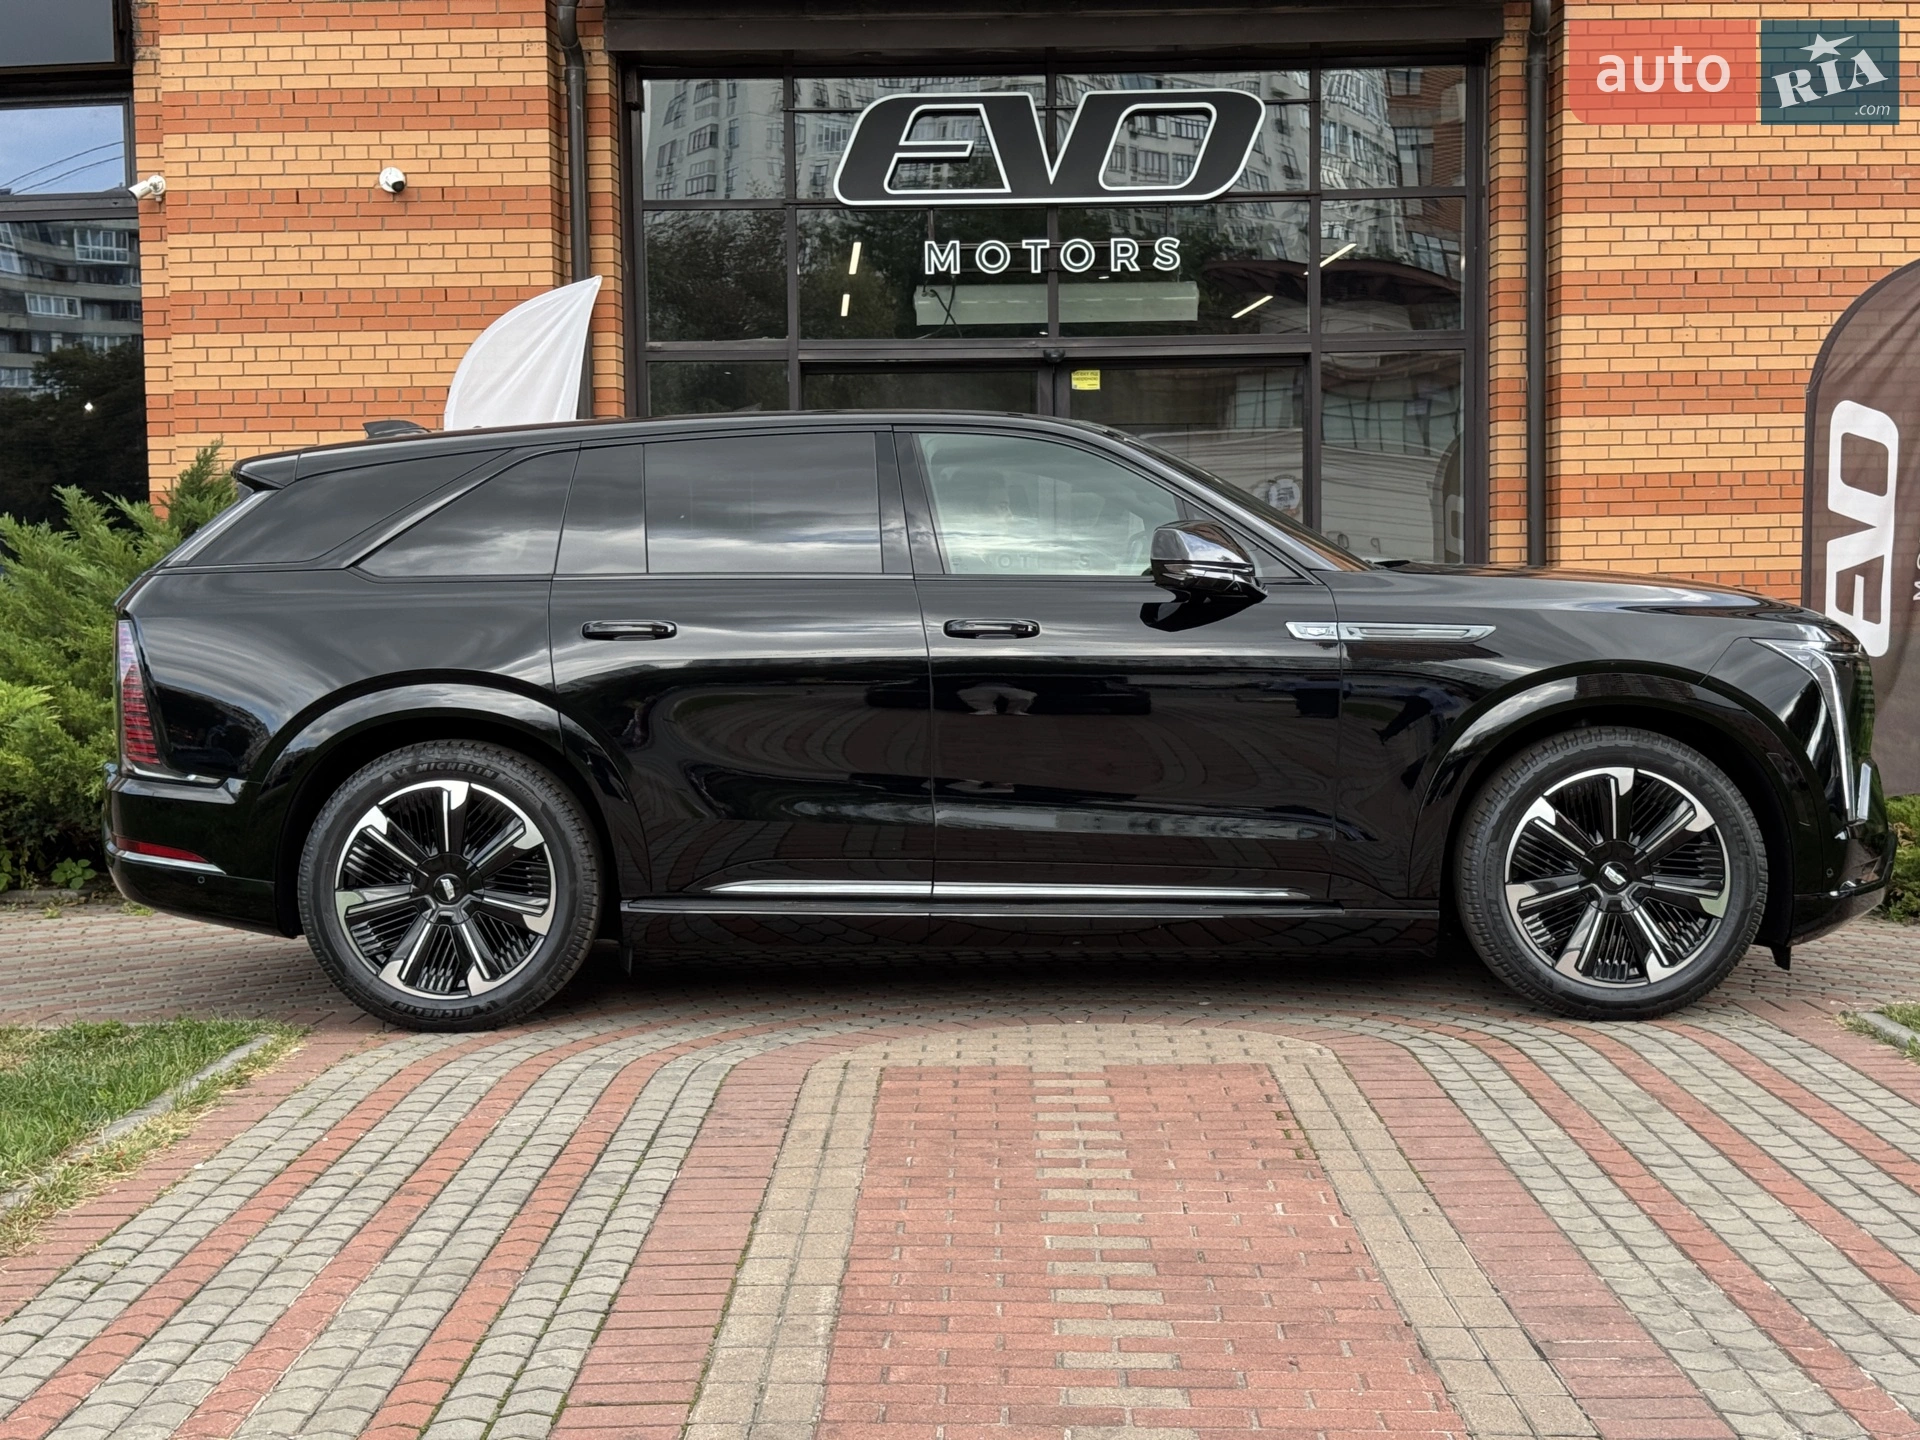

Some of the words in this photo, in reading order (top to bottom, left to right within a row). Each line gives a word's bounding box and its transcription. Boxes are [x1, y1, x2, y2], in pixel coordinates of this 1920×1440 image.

[833, 88, 1267, 206] EVO
[924, 237, 1181, 275] MOTORS
[1825, 399, 1899, 658] EVO
[415, 762, 496, 778] MICHELIN
[395, 1002, 474, 1018] MICHELIN
